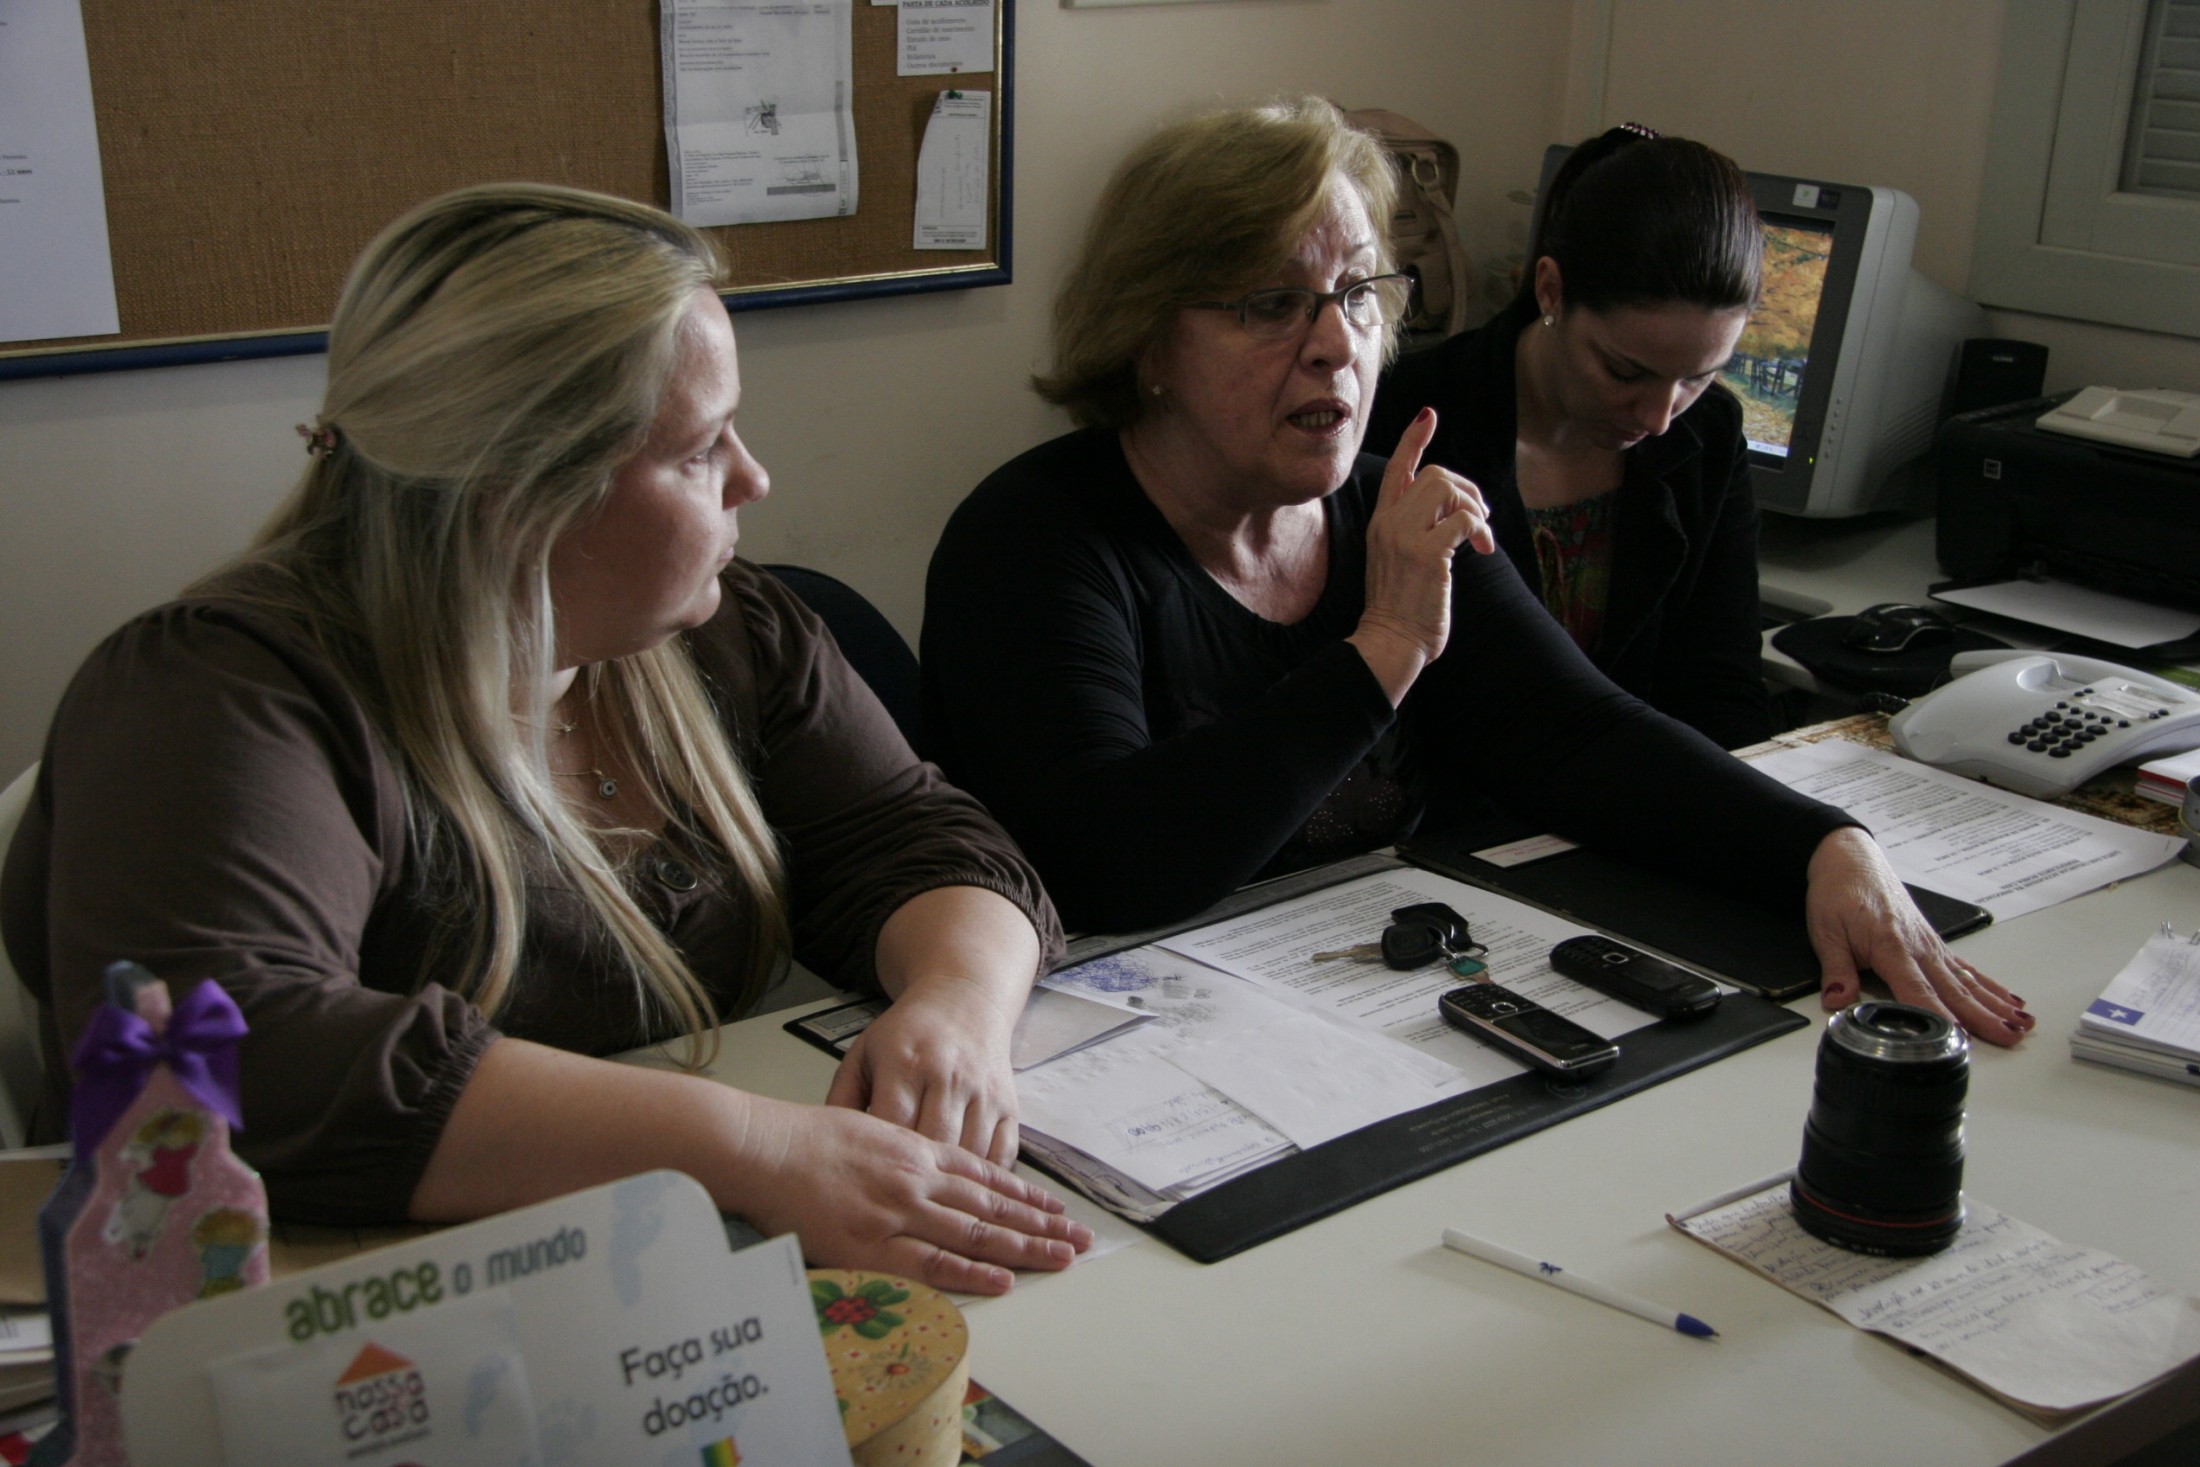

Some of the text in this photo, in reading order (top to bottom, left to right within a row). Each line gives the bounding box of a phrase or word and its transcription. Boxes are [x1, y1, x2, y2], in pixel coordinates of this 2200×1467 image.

[284, 1227, 587, 1342] abrace o mundo
[619, 1316, 764, 1386] Faça sua
[335, 1370, 426, 1413] nossa
[342, 1397, 429, 1439] casa
[643, 1373, 770, 1437] doação.
